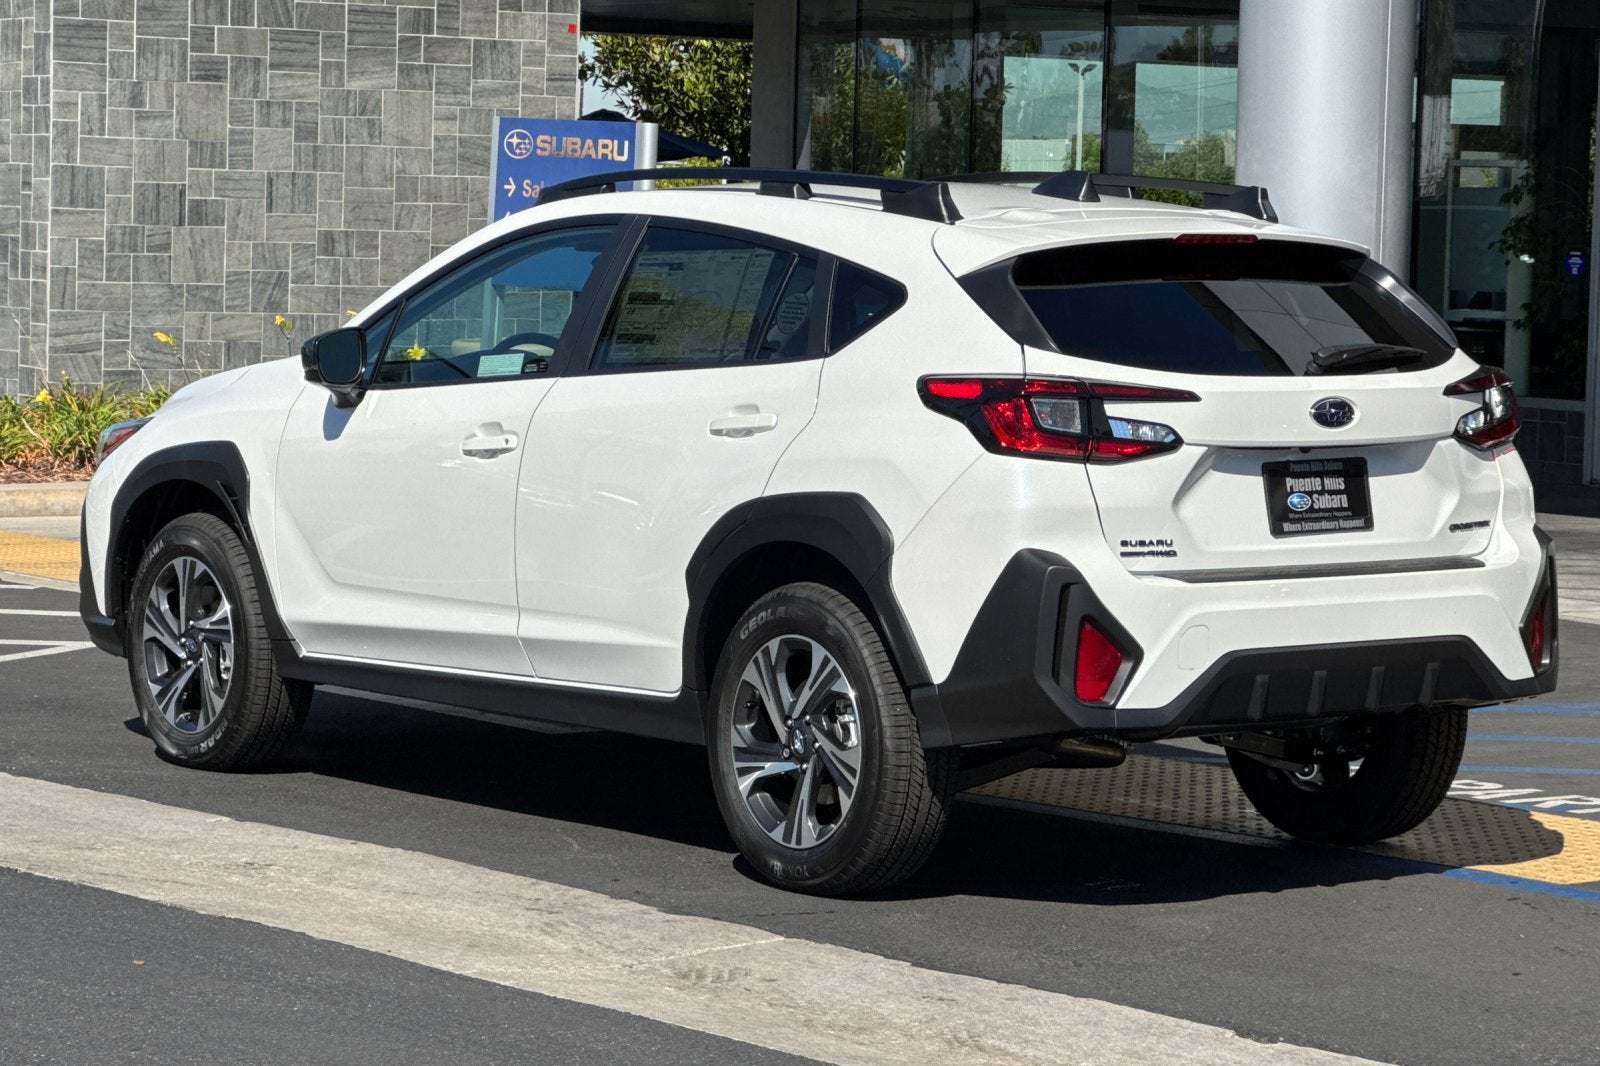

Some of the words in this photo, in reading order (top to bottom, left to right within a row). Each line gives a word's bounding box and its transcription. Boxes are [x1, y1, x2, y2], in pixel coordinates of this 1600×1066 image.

[536, 134, 629, 162] SUBARU
[1286, 477, 1322, 492] Puente
[1323, 475, 1345, 490] Hills
[1312, 493, 1348, 509] Subaru
[1282, 522, 1302, 532] Where
[1302, 520, 1339, 531] Extraordinary
[1119, 539, 1174, 548] SUBARU
